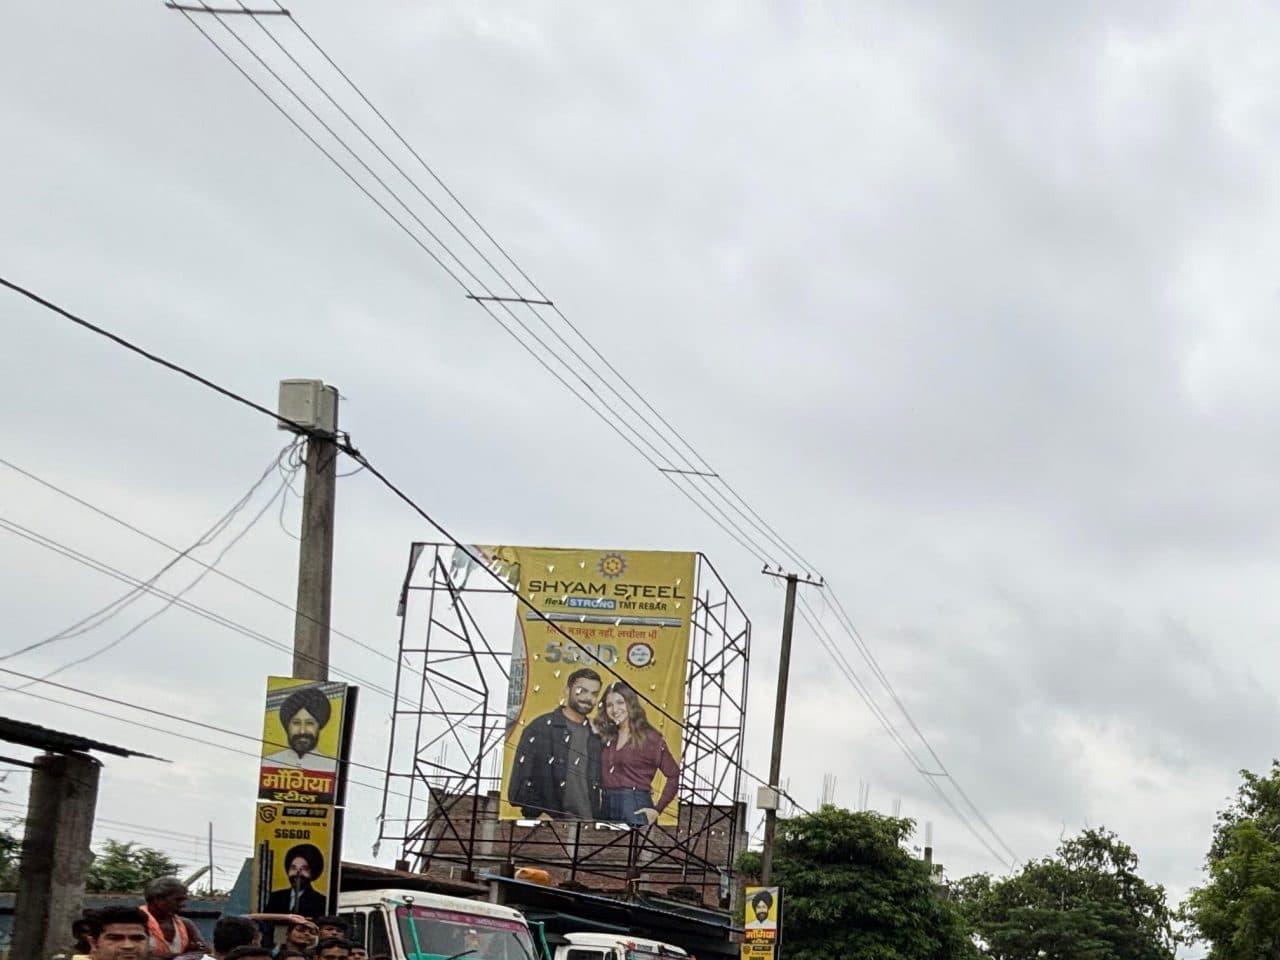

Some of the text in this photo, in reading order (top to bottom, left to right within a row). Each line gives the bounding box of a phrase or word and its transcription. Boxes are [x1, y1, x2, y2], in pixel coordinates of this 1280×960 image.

[528, 580, 686, 599] SHYAM STEEL
[619, 602, 637, 610] TMT
[639, 602, 667, 611] REBAR
